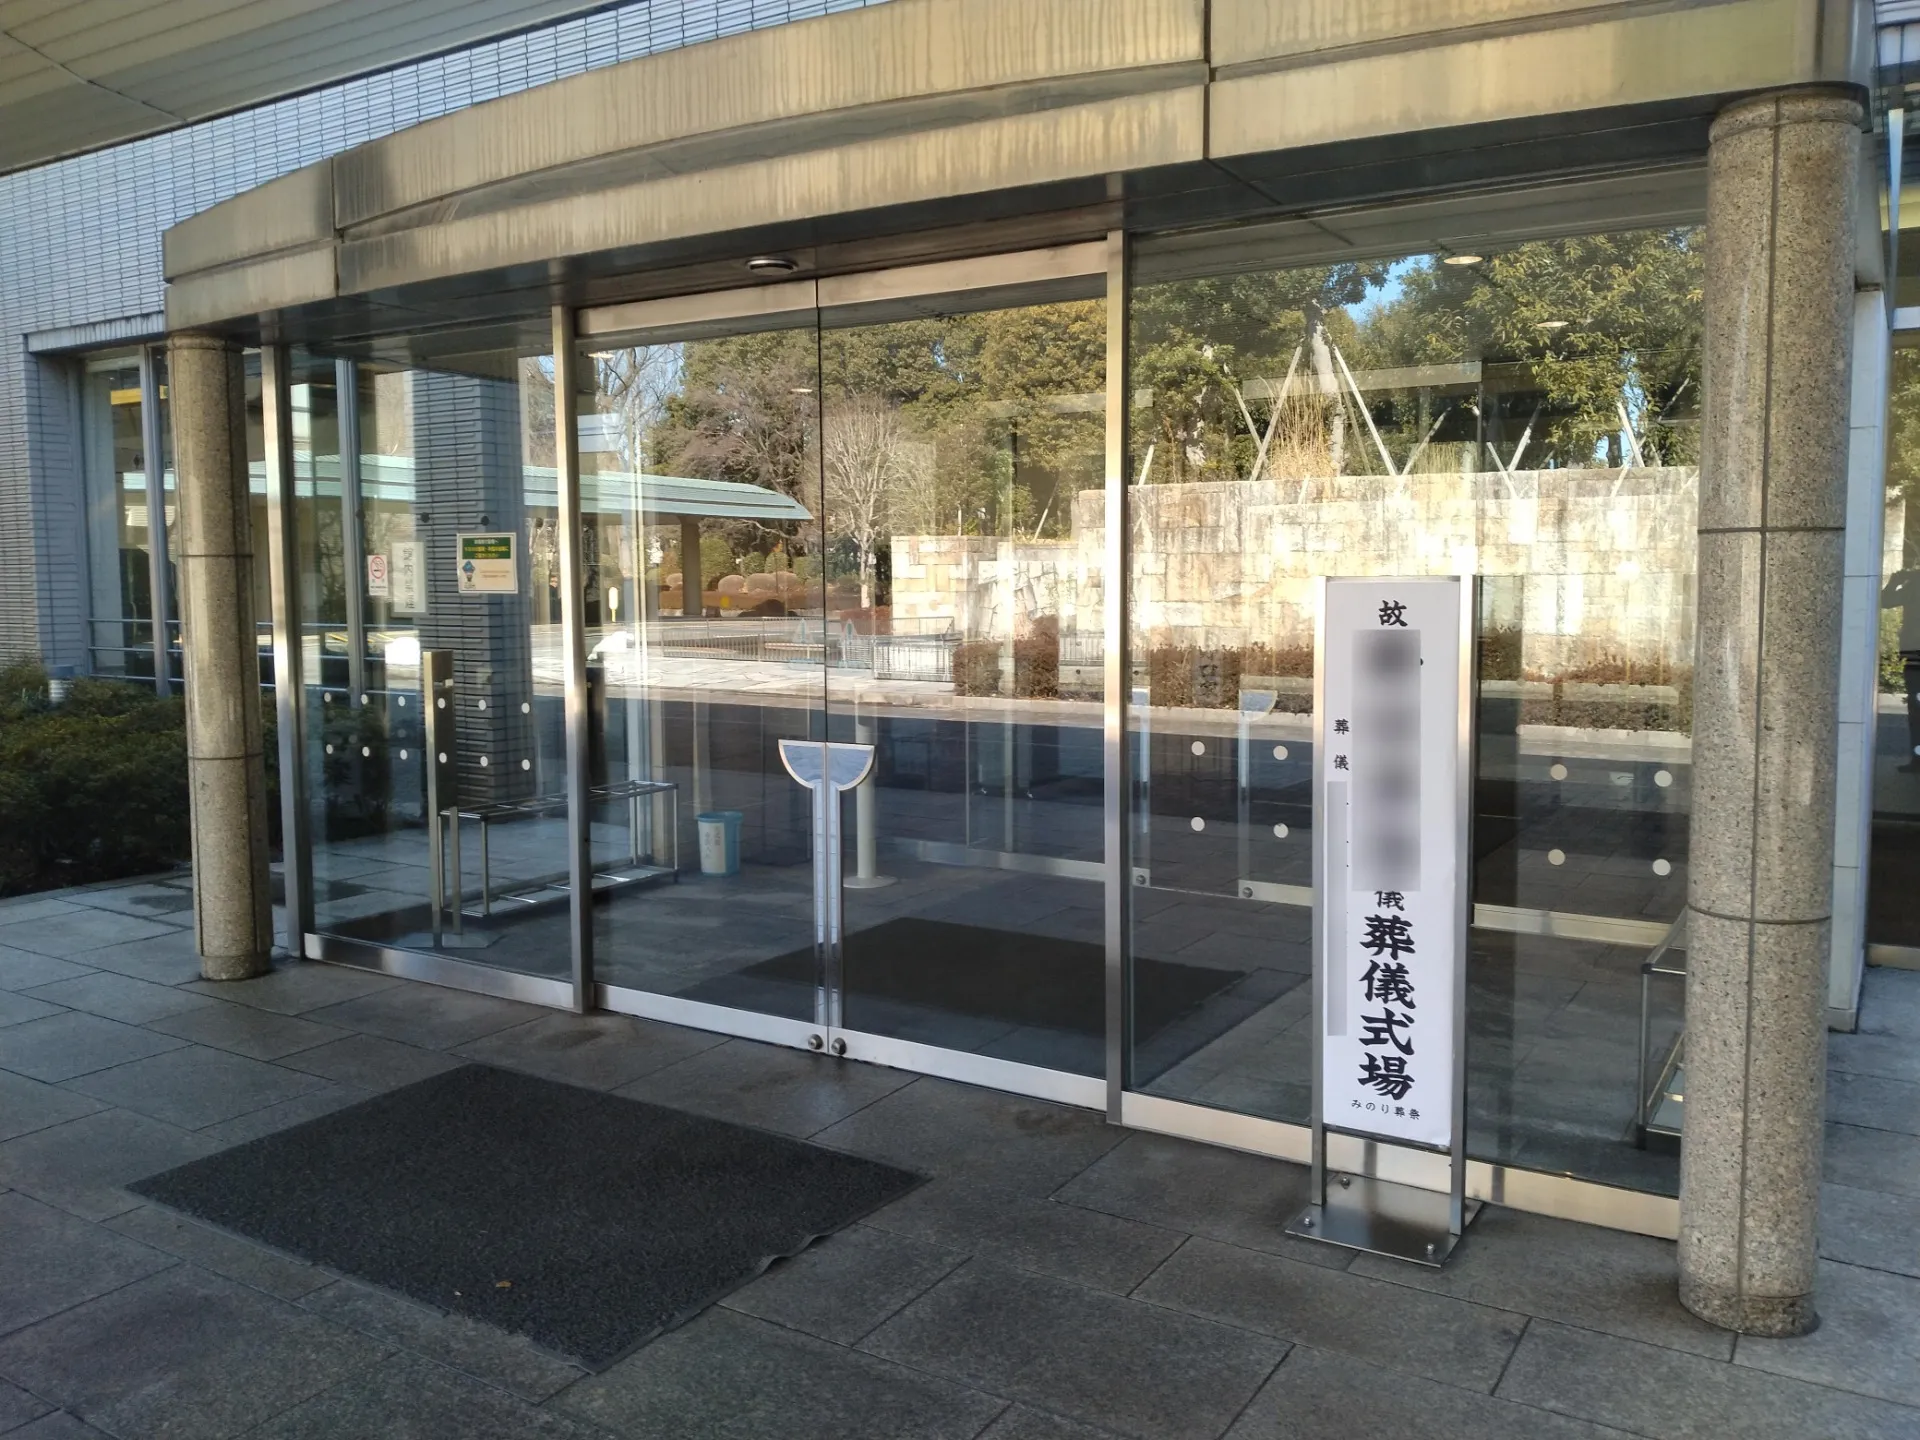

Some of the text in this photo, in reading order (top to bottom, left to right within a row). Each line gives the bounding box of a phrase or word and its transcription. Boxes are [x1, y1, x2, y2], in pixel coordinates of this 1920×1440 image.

[1378, 599, 1408, 627] 故
[1333, 718, 1350, 771] 葬儀
[1358, 914, 1416, 1101] 葬儀式場
[1351, 1099, 1421, 1120] みのり葬祭
